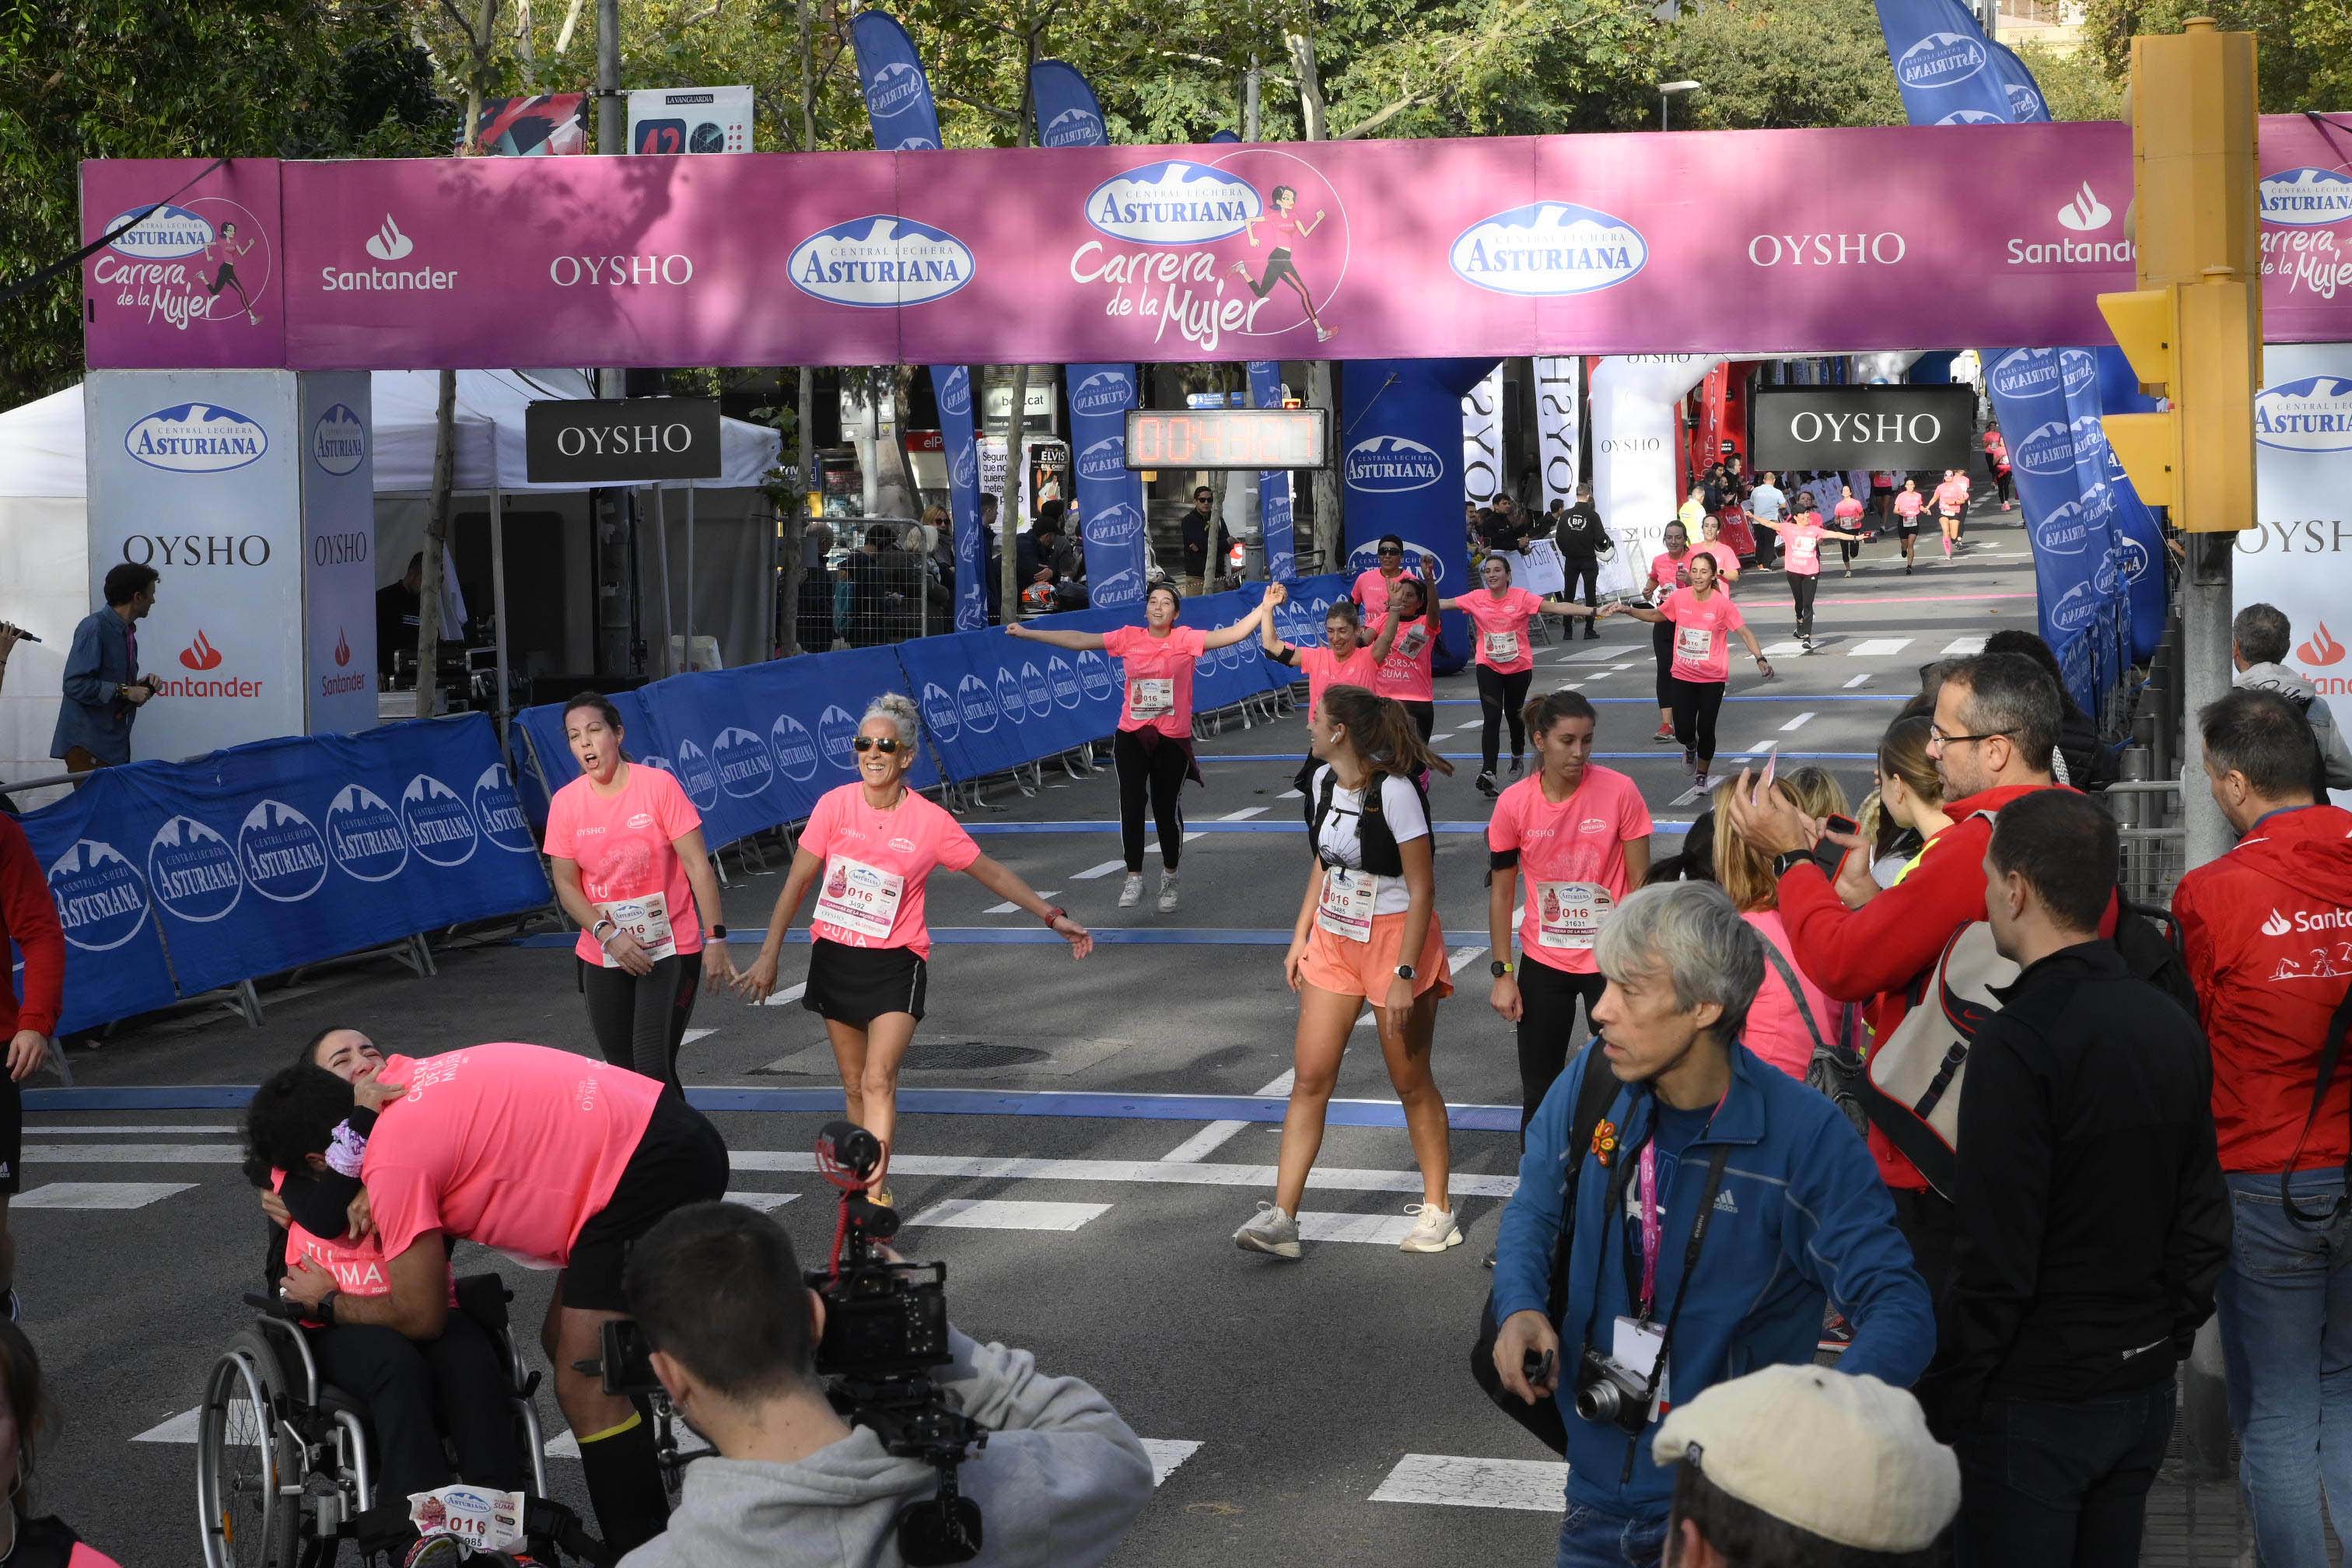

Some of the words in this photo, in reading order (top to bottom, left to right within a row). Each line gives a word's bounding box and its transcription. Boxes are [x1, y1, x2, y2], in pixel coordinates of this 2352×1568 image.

[1126, 189, 1180, 198] CENTRAL
[1098, 192, 1248, 224] ASTURIANA
[112, 223, 205, 245] ASTURIANA
[2260, 229, 2335, 252] arrera
[831, 247, 889, 256] CENTRAL
[895, 247, 954, 255] LECHERA
[1466, 239, 1632, 272] ASTURIANA
[1748, 232, 1906, 267] OYSHO
[94, 255, 185, 285] Carrera
[550, 254, 693, 286] OYSHO
[802, 250, 960, 283] ASTURIANA
[1070, 240, 1215, 285] Carrera
[2279, 254, 2292, 275] la
[2288, 249, 2352, 299] Muje
[322, 266, 458, 291] Santander
[117, 286, 134, 306] de
[138, 287, 149, 306] la
[148, 280, 220, 331] Mujer
[1106, 286, 1132, 317] de
[1139, 286, 1158, 317] la
[1154, 278, 1271, 351] Mujer
[1791, 412, 1941, 443] OYSHO
[2256, 405, 2352, 434] ASTURI
[136, 429, 257, 455] ASTURIANA
[317, 429, 362, 458] ASTURIANA
[558, 423, 692, 457] OYSHO
[1601, 437, 1660, 454] OYSHO
[983, 464, 996, 473] que
[1041, 451, 1066, 461] ELVIS
[1348, 458, 1437, 480] ASTURIANA
[123, 534, 270, 566] OYSHO
[315, 531, 366, 566] OYSHO
[322, 670, 366, 697] Santander
[1083, 671, 1110, 690] ASTURIANA
[1381, 669, 1409, 679] SUMA
[155, 676, 263, 698] antander
[777, 742, 815, 767] ASTURIANA
[408, 810, 474, 846] ASTURIANA
[481, 800, 524, 834] ASTUR
[255, 835, 284, 849] CENTRAL
[334, 824, 405, 861] ASTURIANA
[247, 842, 324, 880] ASTURIANA
[158, 859, 238, 901] ASTURIANA
[589, 883, 609, 898] TU
[848, 887, 873, 902] 016
[1330, 892, 1349, 906] 016
[1562, 908, 1588, 918] 016
[331, 1262, 383, 1286] MA
[447, 1496, 488, 1511] ASTURIANA
[493, 1503, 516, 1511] SUMA
[450, 1517, 487, 1535] 016
[462, 1536, 482, 1547] 985
